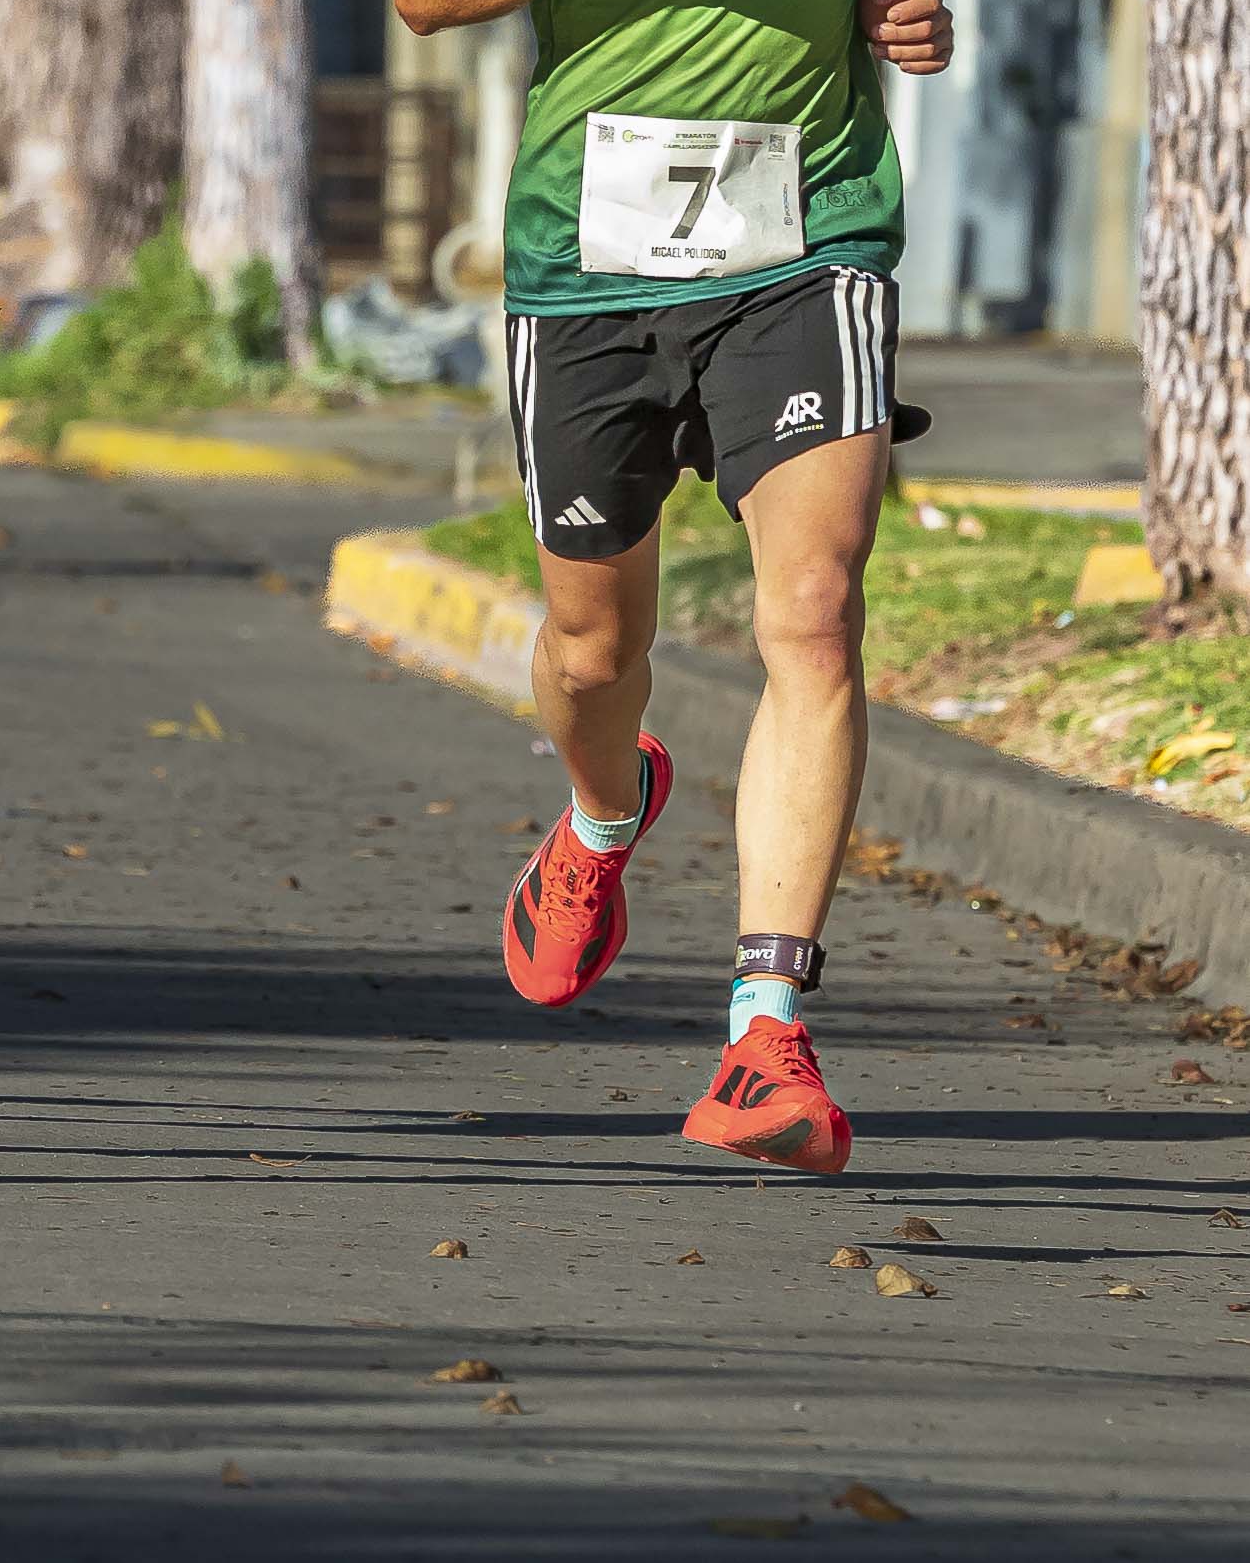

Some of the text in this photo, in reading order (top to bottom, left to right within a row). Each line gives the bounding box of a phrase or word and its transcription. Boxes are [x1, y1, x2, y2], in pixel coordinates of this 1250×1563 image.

[668, 166, 716, 240] 7
[651, 246, 727, 261] MICAEL POLIDORO
[774, 391, 824, 433] AR
